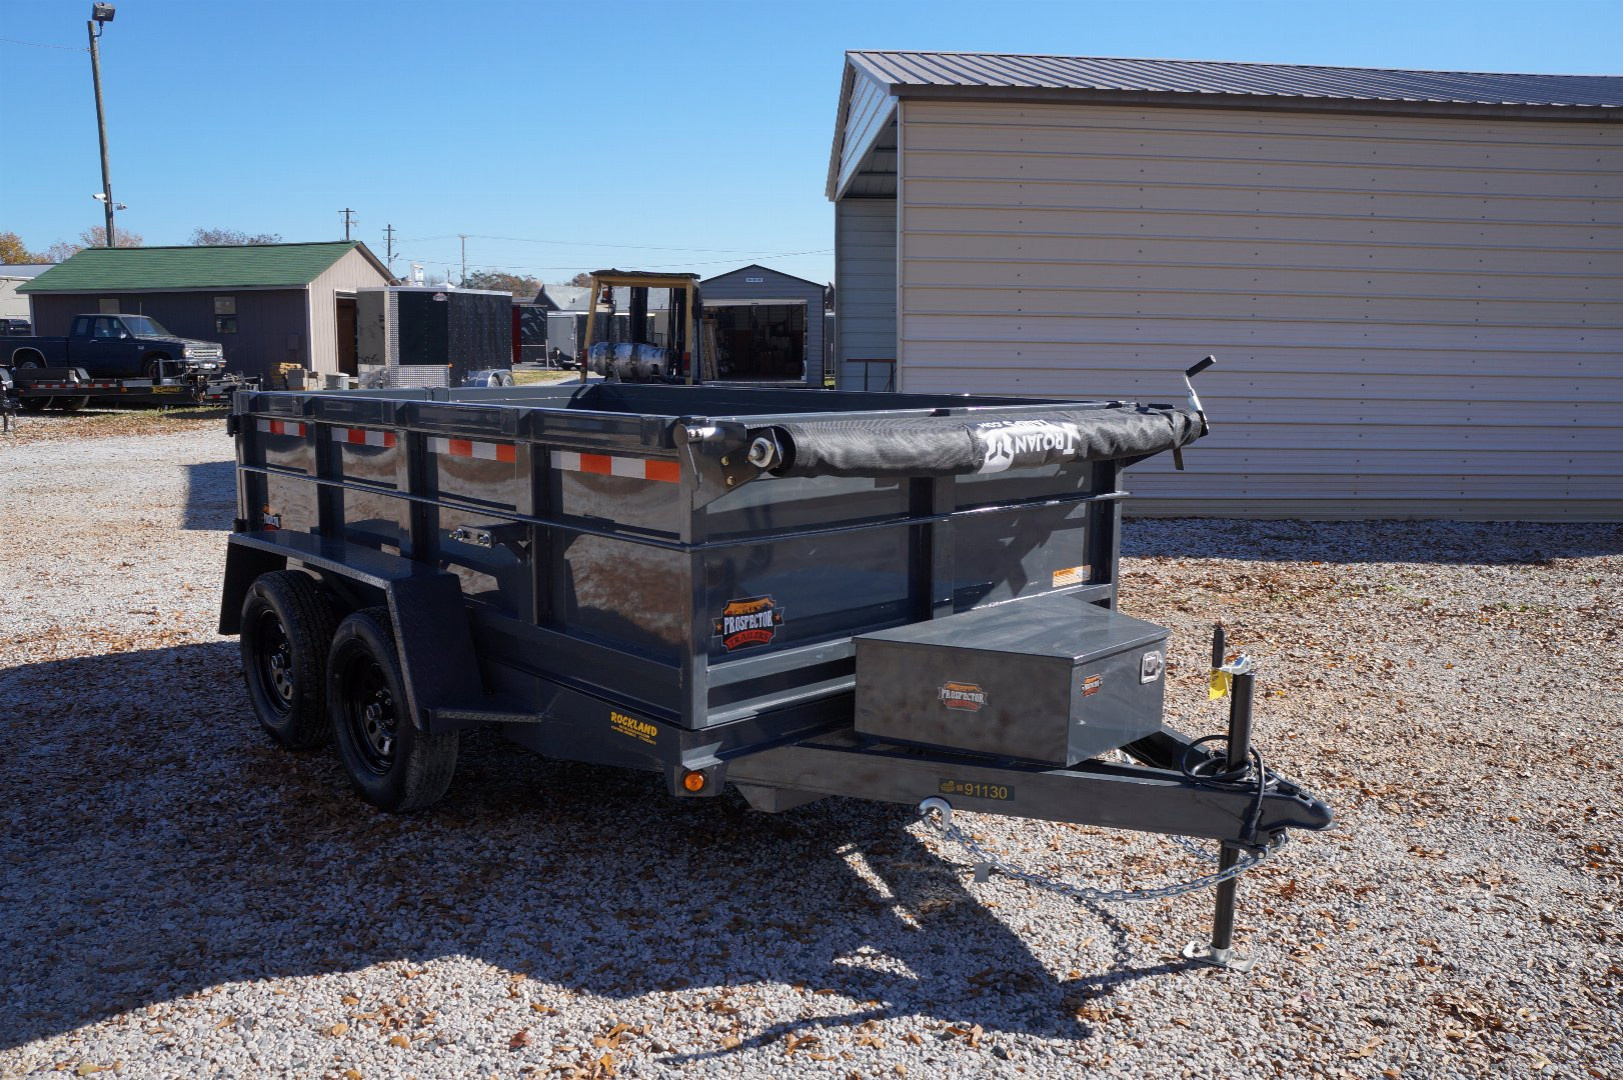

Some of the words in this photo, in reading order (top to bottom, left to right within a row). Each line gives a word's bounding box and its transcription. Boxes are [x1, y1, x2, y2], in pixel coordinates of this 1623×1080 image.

[723, 610, 773, 635] PROSPECTOR
[610, 711, 658, 737] ROCKLAND
[964, 783, 1008, 799] 91130
